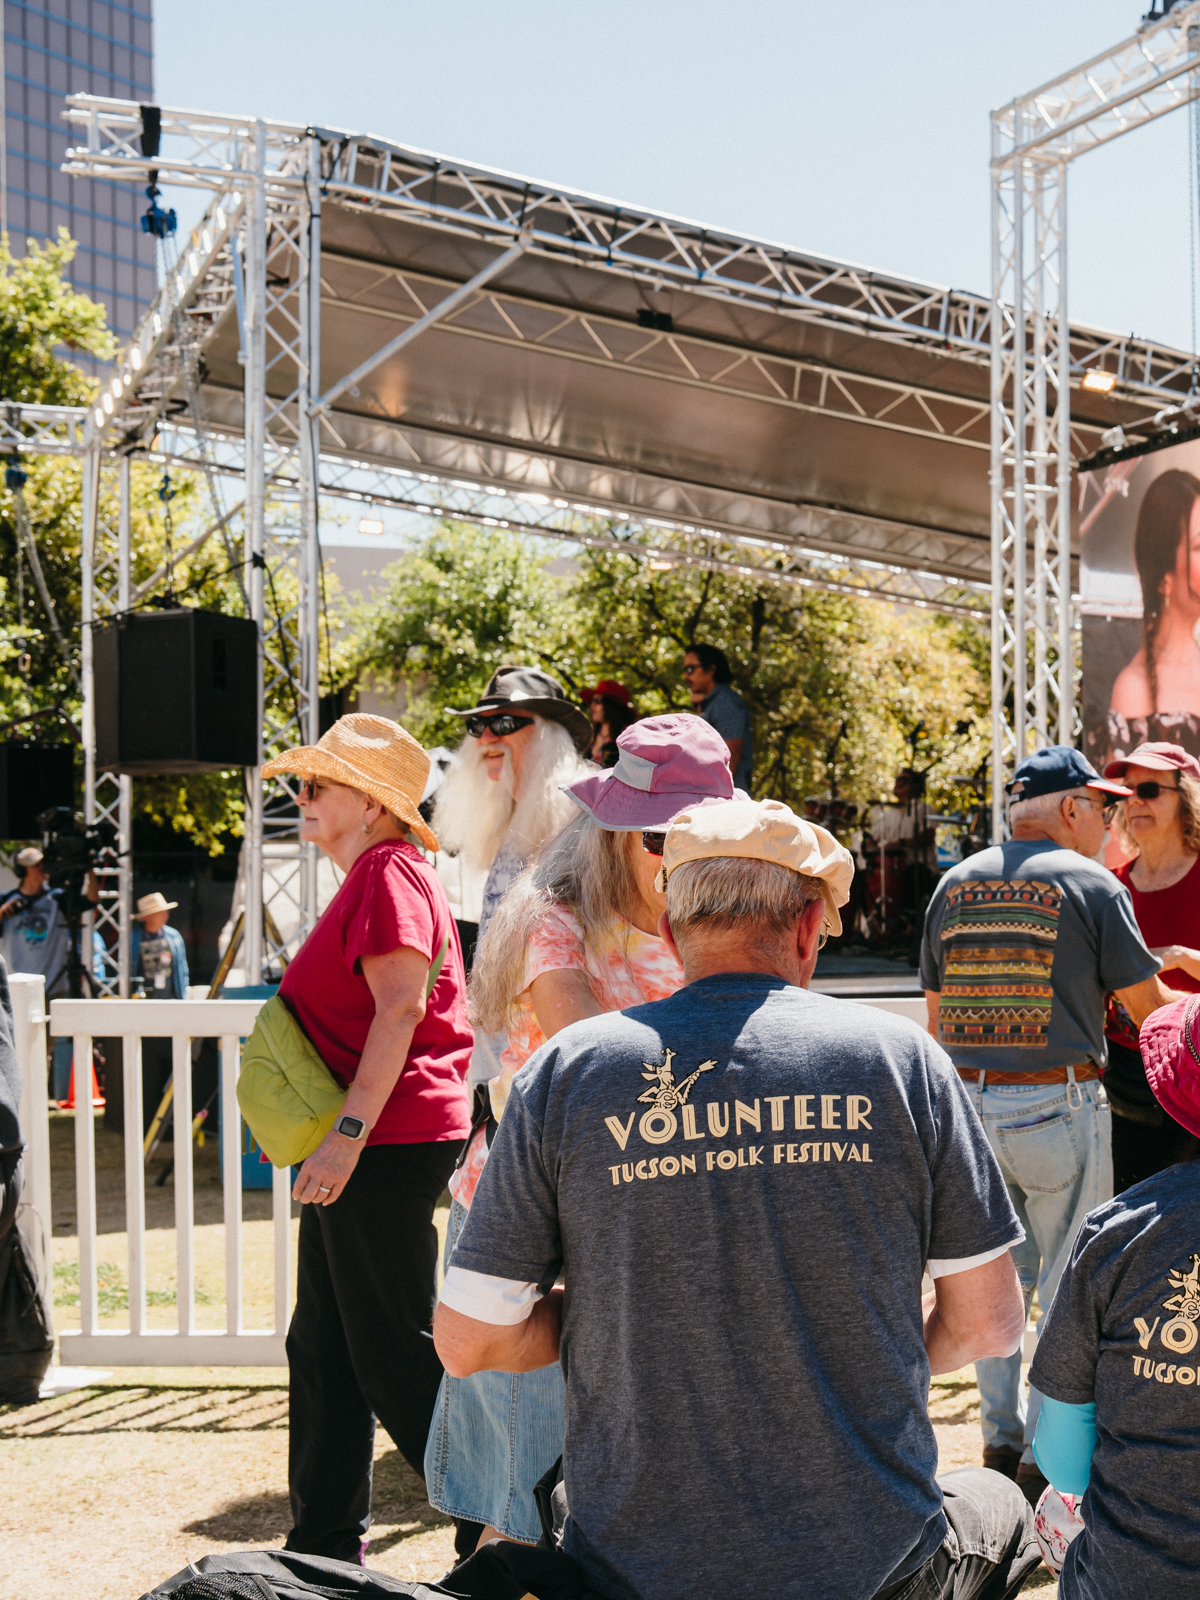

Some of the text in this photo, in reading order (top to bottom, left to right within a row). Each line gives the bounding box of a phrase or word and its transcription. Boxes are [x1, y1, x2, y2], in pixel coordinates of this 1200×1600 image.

[604, 1095, 873, 1151] VOLUNTEER
[608, 1142, 873, 1185] TUCSON FOLK FESTIVAL
